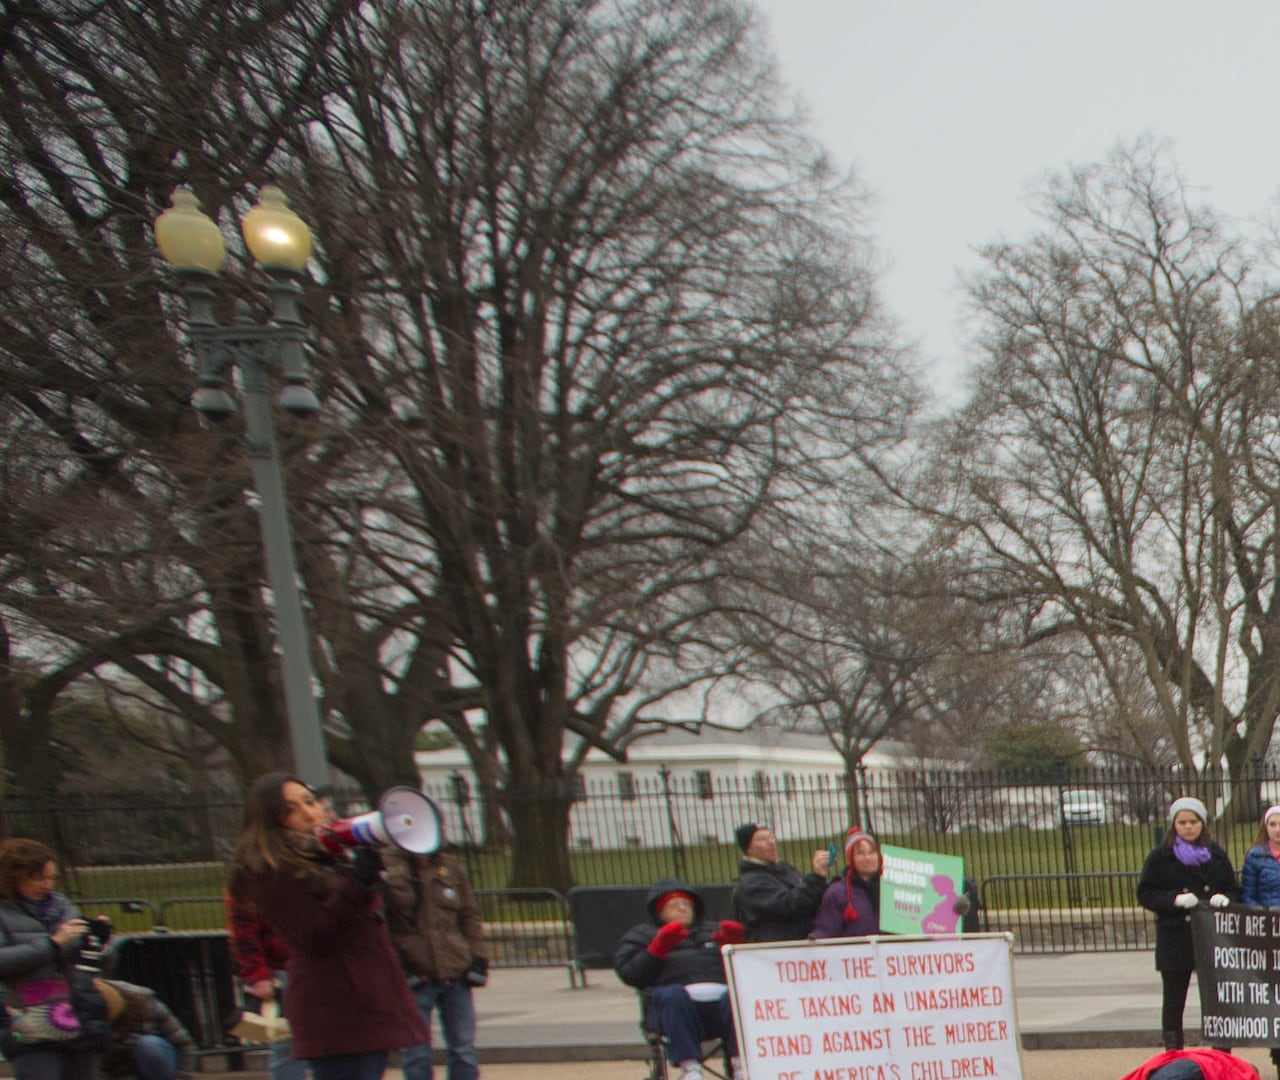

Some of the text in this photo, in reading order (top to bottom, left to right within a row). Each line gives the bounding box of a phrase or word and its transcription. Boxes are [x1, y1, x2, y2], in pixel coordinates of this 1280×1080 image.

[1214, 912, 1240, 934] THEY
[1245, 916, 1266, 936] ARE
[842, 956, 877, 979] THE
[886, 952, 975, 976] SURVIVORS
[1214, 946, 1267, 970] POSITION
[754, 986, 1003, 1022] ARE TAKING AN UNASHAMED
[1217, 981, 1244, 1004] WITH
[1248, 982, 1270, 1004] THE
[756, 1020, 1008, 1057] STAND AGAINST THE MURDER
[1203, 1015, 1268, 1039] PERSONHOOD
